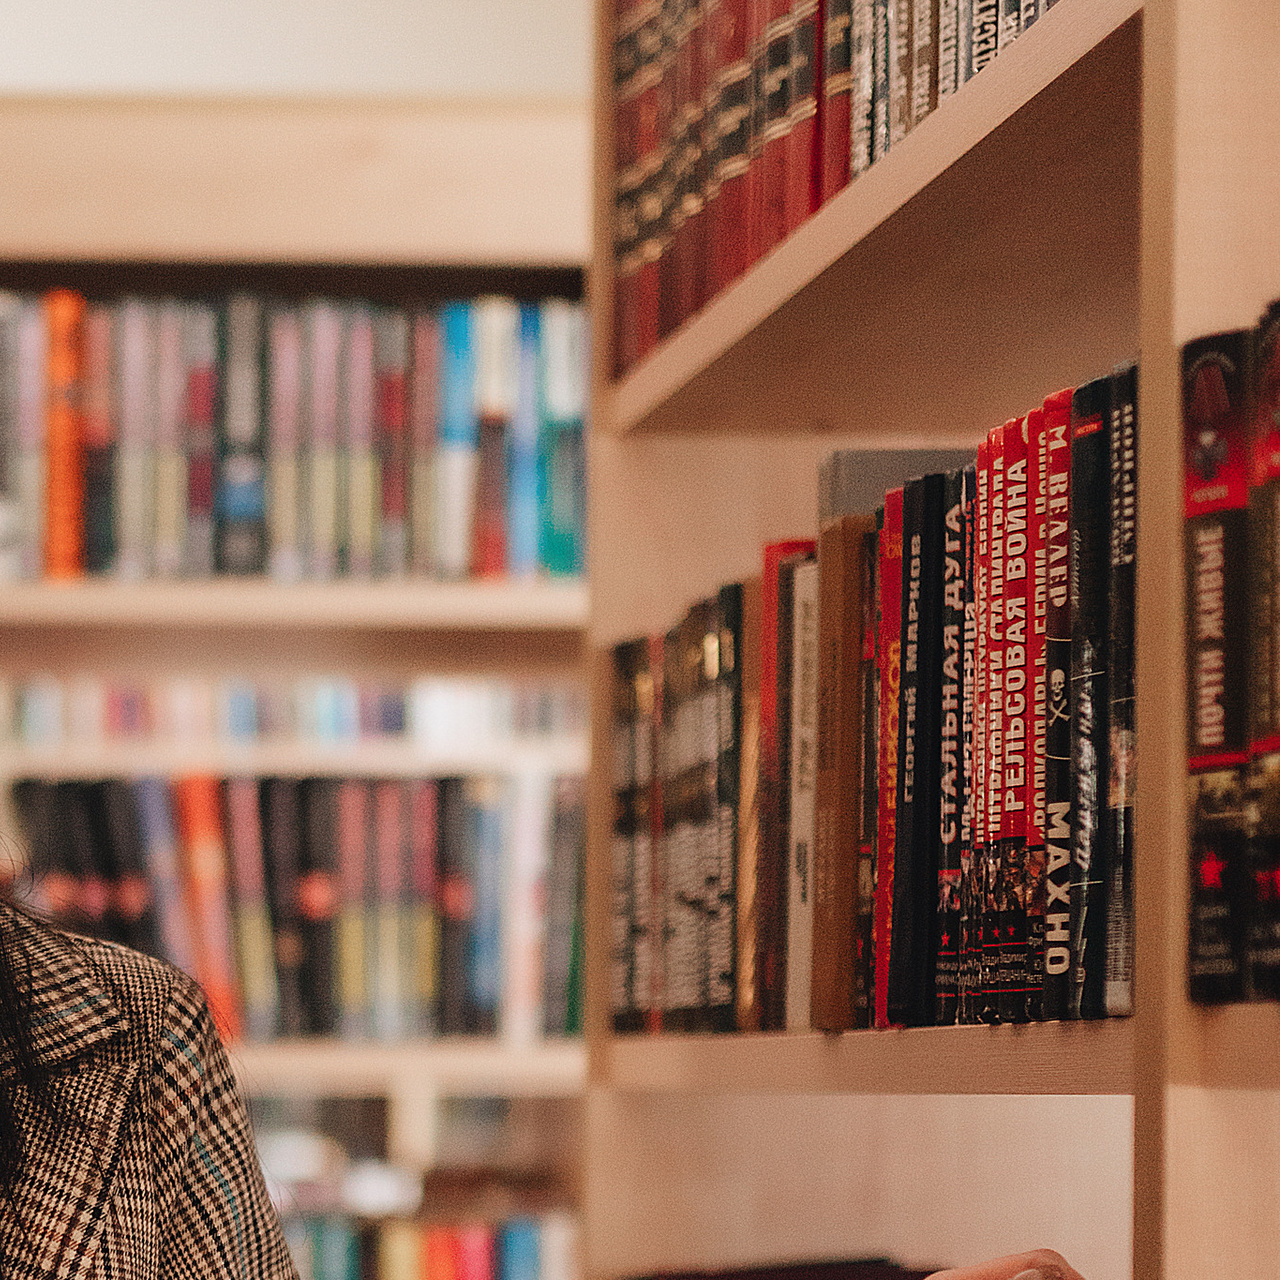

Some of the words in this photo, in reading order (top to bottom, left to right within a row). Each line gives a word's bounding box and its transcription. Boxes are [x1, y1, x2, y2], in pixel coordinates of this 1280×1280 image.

[1048, 424, 1068, 463] М.
[944, 503, 964, 611] ДУГА
[1003, 458, 1028, 581] ВОЙНА
[1047, 472, 1068, 608] ВЕЛЛЕР
[906, 534, 921, 673] МАРКОВ
[1195, 525, 1224, 639] ЖИВЫЕ
[903, 687, 917, 803] ГЕОРГИЙ
[940, 624, 960, 844] СТАЛЬНАЯ
[1004, 595, 1027, 812] РЕЛЬСОВАЯ
[1196, 650, 1224, 746] ПОЧТИ
[1046, 801, 1071, 976] МАХНО
